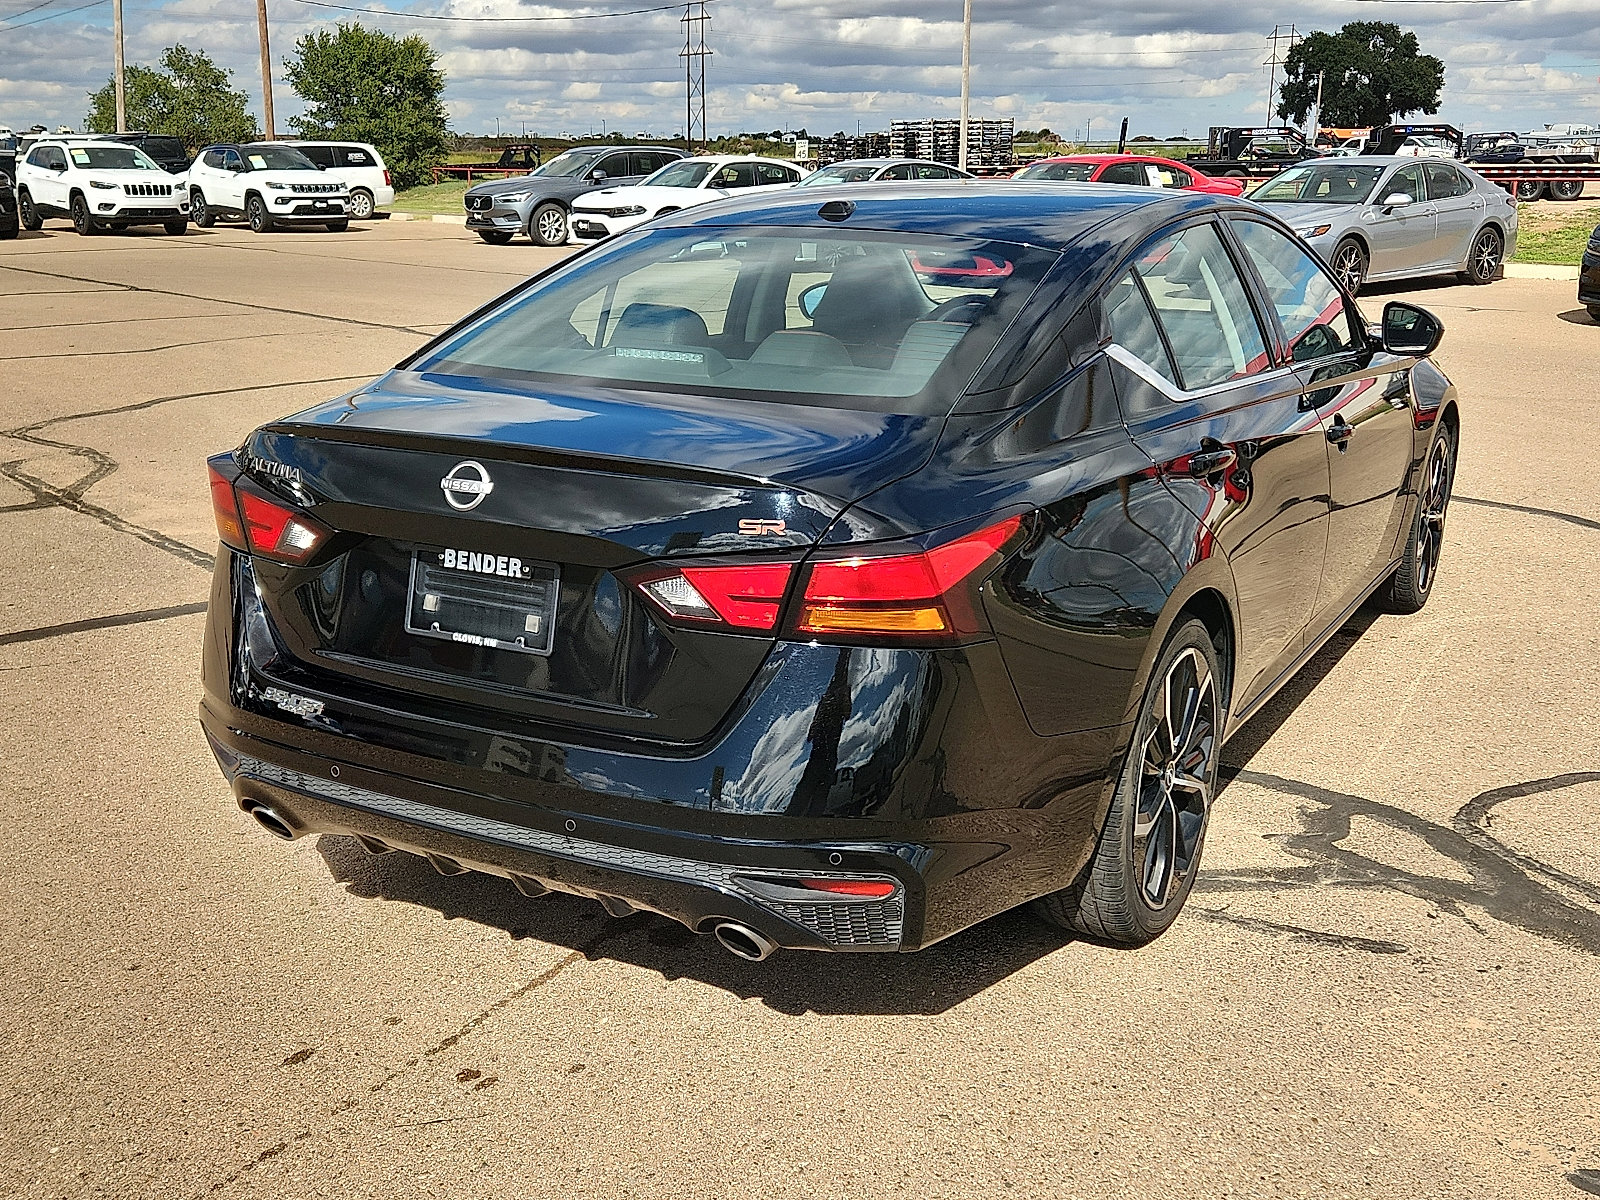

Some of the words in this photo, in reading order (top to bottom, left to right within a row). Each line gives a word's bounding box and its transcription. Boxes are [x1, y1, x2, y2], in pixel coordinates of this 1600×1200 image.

[797, 150, 807, 159] 45
[249, 457, 303, 483] ALTIMA
[440, 478, 494, 494] NISSAN
[738, 518, 787, 536] SR
[443, 548, 523, 578] BENDER
